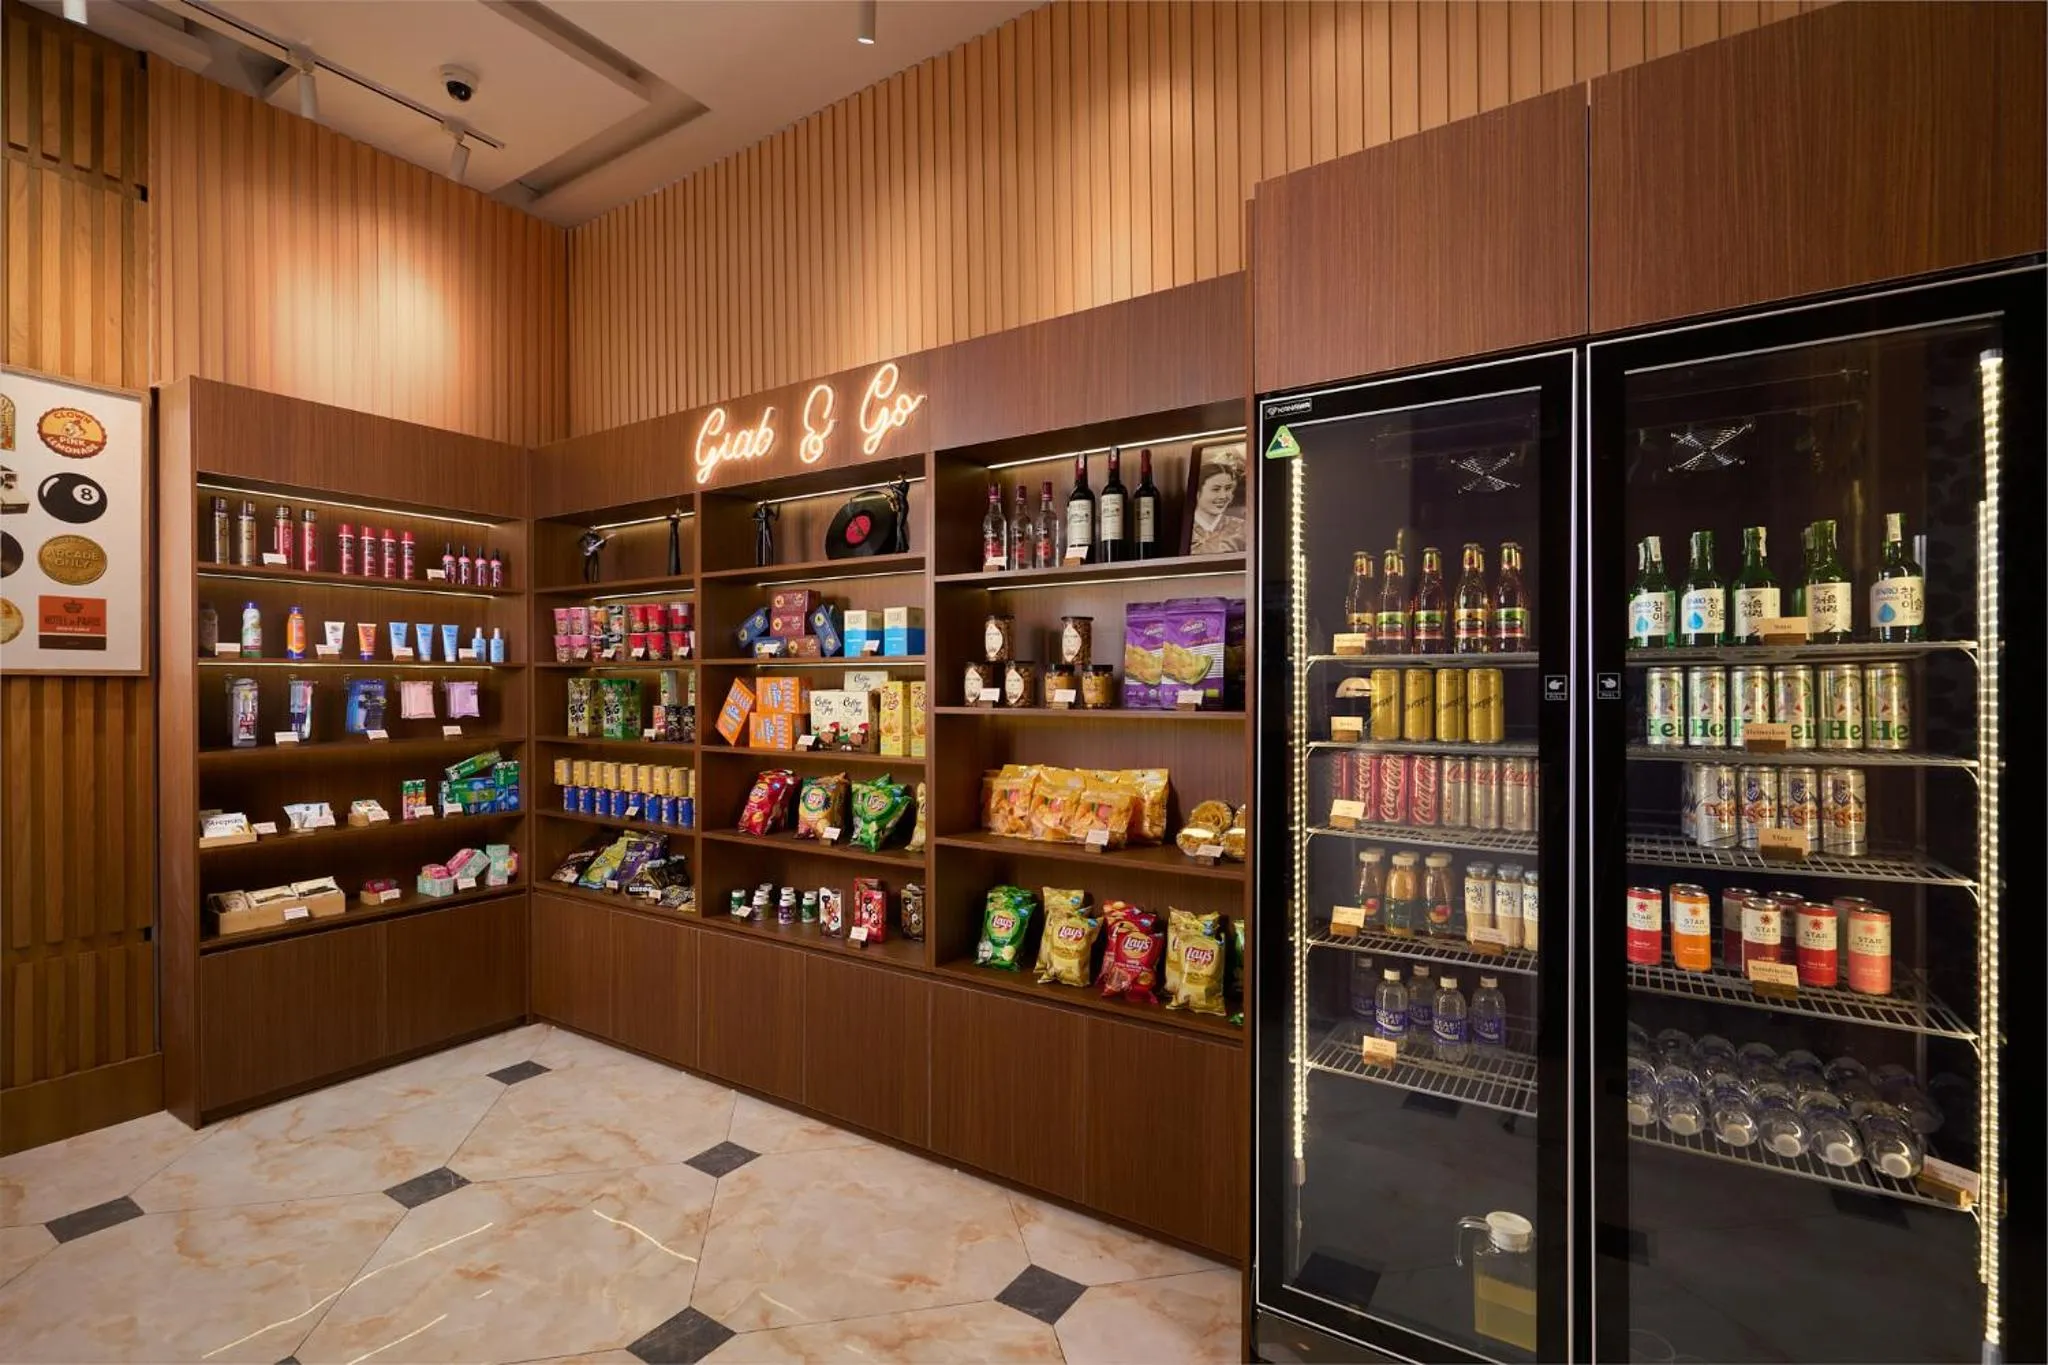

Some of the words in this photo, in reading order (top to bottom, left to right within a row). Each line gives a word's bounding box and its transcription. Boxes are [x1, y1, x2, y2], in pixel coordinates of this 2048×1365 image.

[53, 411, 92, 424] CLOWN
[695, 407, 775, 484] Grab
[800, 384, 837, 464] &
[860, 362, 928, 456] Go
[81, 488, 92, 501] 8
[44, 547, 100, 561] ARCADE
[54, 558, 92, 569] ONLY
[1684, 918, 1706, 926] STAR
[1059, 926, 1084, 941] Lay's
[1755, 925, 1778, 934] STAR
[1804, 930, 1828, 940] STAR
[1124, 936, 1150, 953] Lay's
[1857, 935, 1885, 945] STAR
[1185, 947, 1215, 965] Lay's
